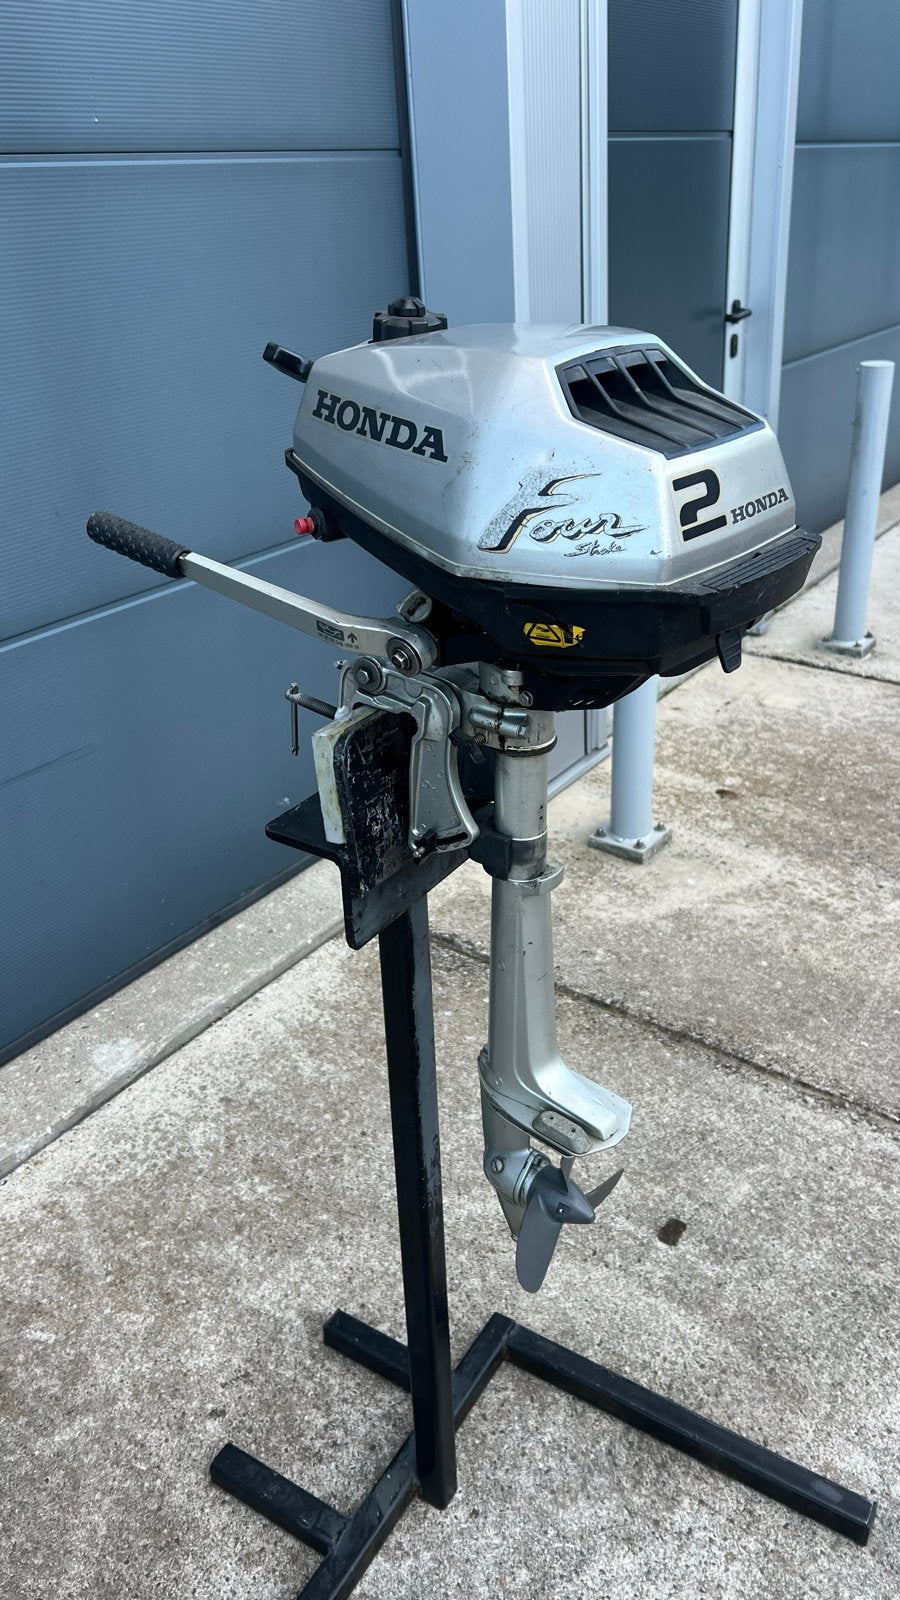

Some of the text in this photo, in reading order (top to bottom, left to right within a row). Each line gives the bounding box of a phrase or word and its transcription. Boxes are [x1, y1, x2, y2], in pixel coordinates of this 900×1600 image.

[312, 389, 448, 463] HONDA
[477, 466, 649, 555] Four
[672, 468, 789, 541] 2 HONDA
